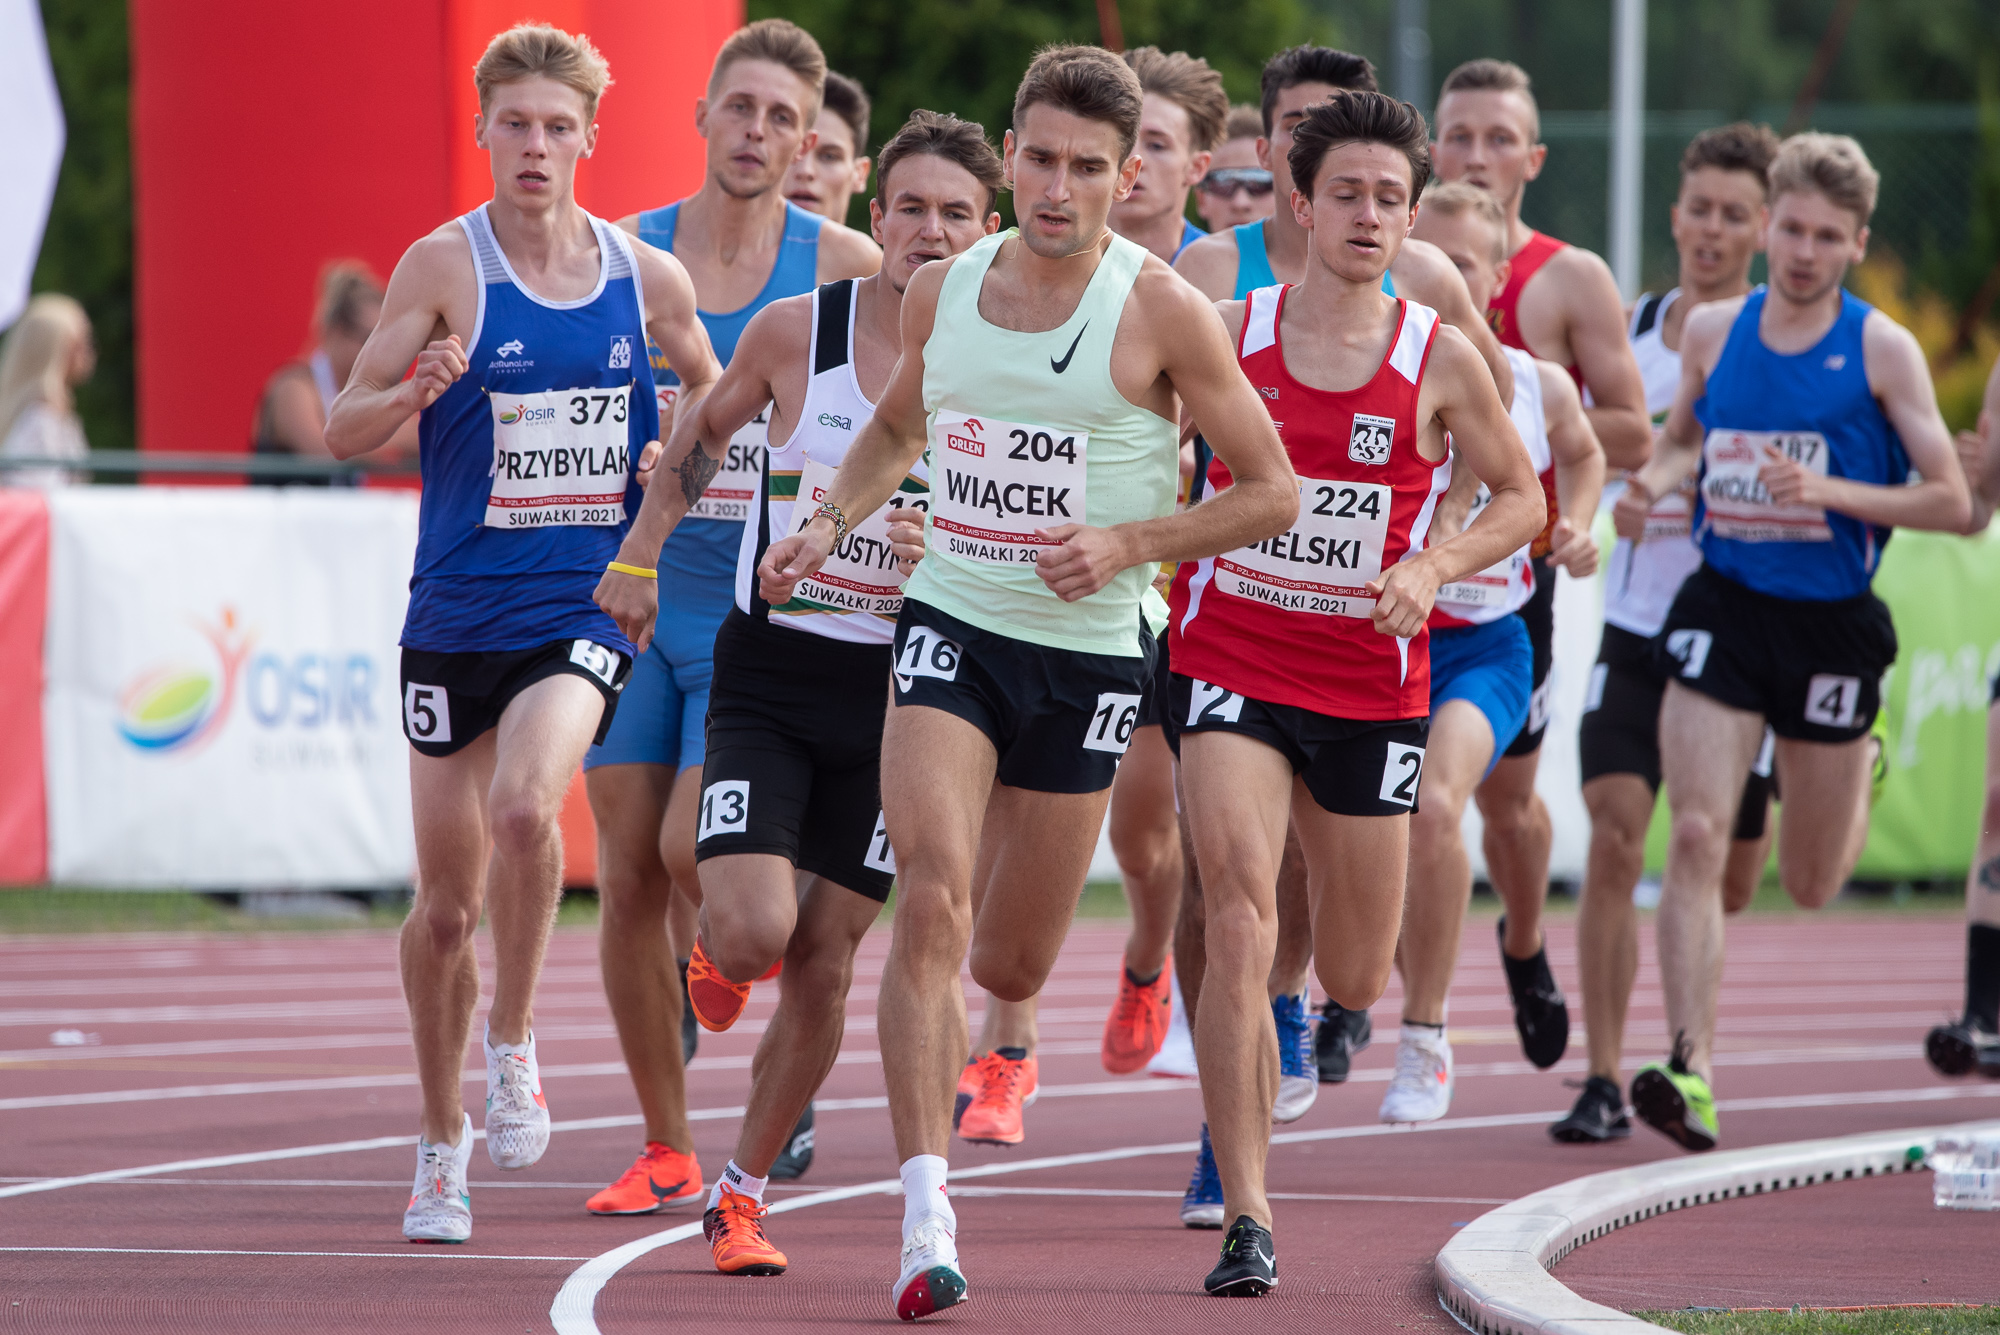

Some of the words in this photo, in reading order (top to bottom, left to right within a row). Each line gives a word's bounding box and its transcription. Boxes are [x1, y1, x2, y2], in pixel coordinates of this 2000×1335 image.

[525, 408, 555, 421] OSIR
[569, 394, 627, 426] 373
[496, 445, 629, 480] PRZYBYLAK
[949, 437, 983, 456] ORLEN
[1008, 429, 1077, 465] 204
[528, 495, 587, 506] MISTRZOSTWA
[589, 495, 618, 503] POLSKI
[714, 503, 748, 516] 2021
[946, 468, 1072, 519] WIĄCEK
[1312, 486, 1381, 520] 224
[509, 509, 576, 526] SUWAŁKI
[581, 508, 616, 522] 2021
[947, 523, 965, 533] PZLA
[965, 527, 1026, 542] MISTRZOSTWA
[949, 537, 1013, 562] SUWAŁKI
[1019, 548, 1039, 562] 20
[1246, 531, 1362, 569] IELSKI
[799, 582, 871, 610] SUWAŁKI
[874, 598, 903, 611] 202
[822, 575, 885, 594] MISTRZOSTWA
[1236, 566, 1257, 579] PZLA
[1257, 574, 1319, 591] MISTRZOSTWA
[1320, 585, 1351, 595] POLSKI
[1352, 589, 1372, 597] U23
[1237, 580, 1305, 609] SUWAŁKI
[1309, 596, 1347, 614] 2021
[906, 635, 958, 672] 16
[413, 689, 437, 737] 5
[1196, 682, 1233, 723] 2
[1817, 681, 1845, 720] 4
[1096, 703, 1138, 744] 16
[1392, 751, 1422, 802] 2
[703, 790, 745, 830] 13
[876, 828, 892, 863] 1
